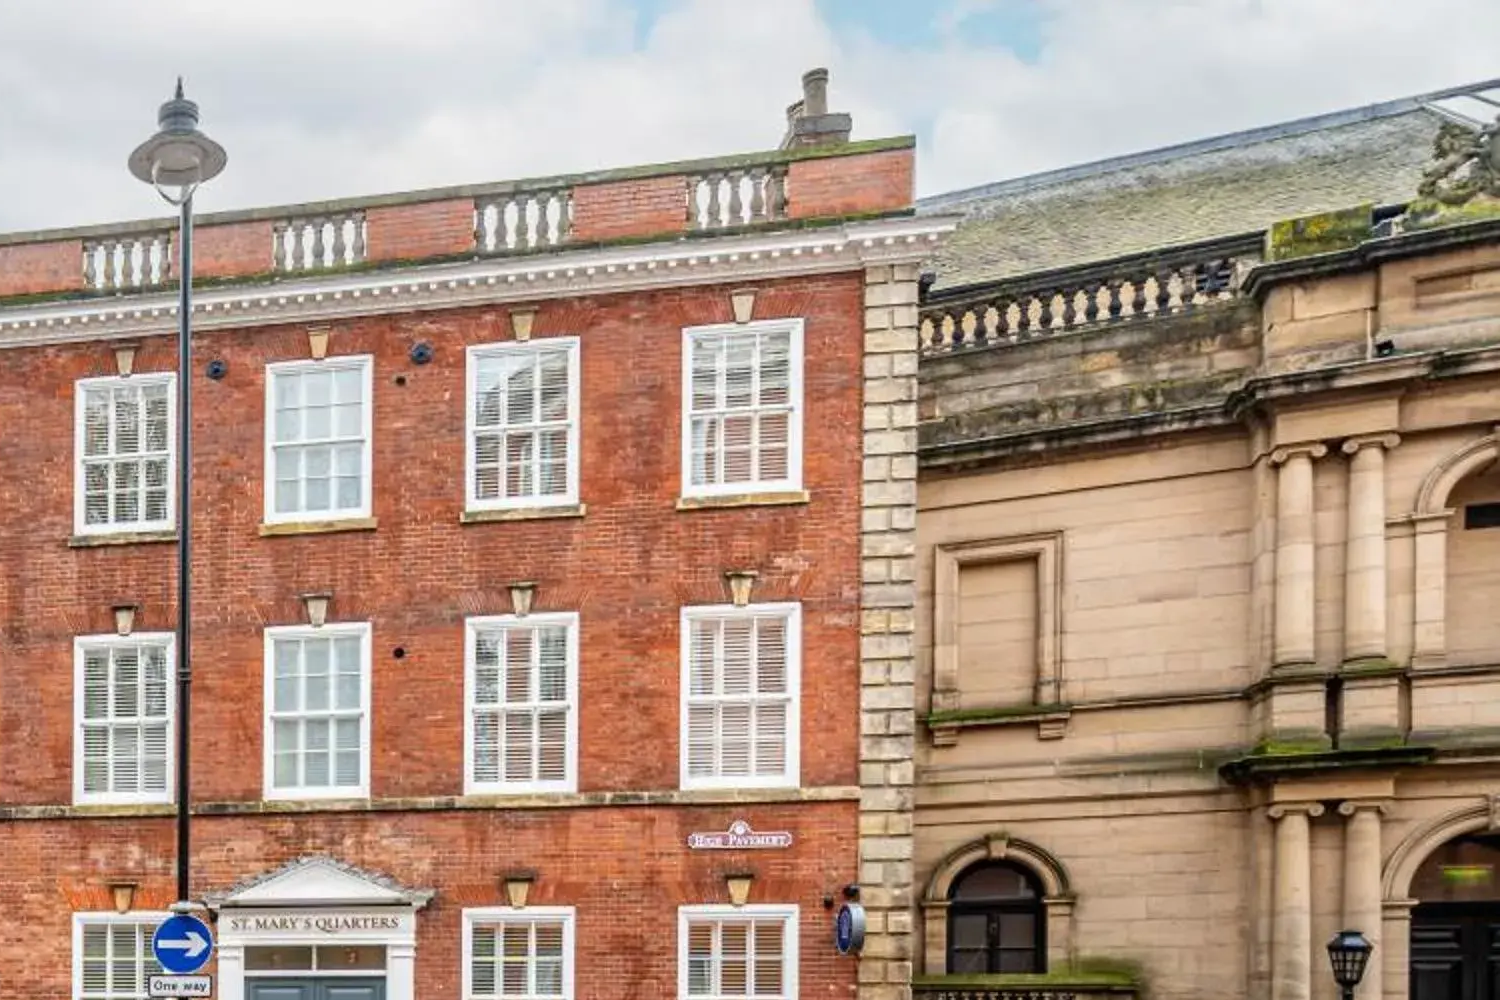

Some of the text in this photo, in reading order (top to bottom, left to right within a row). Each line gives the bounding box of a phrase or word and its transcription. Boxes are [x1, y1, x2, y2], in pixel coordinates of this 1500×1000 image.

[231, 916, 400, 933] ST. MARY'S QUARTERS
[153, 980, 207, 992] One way
